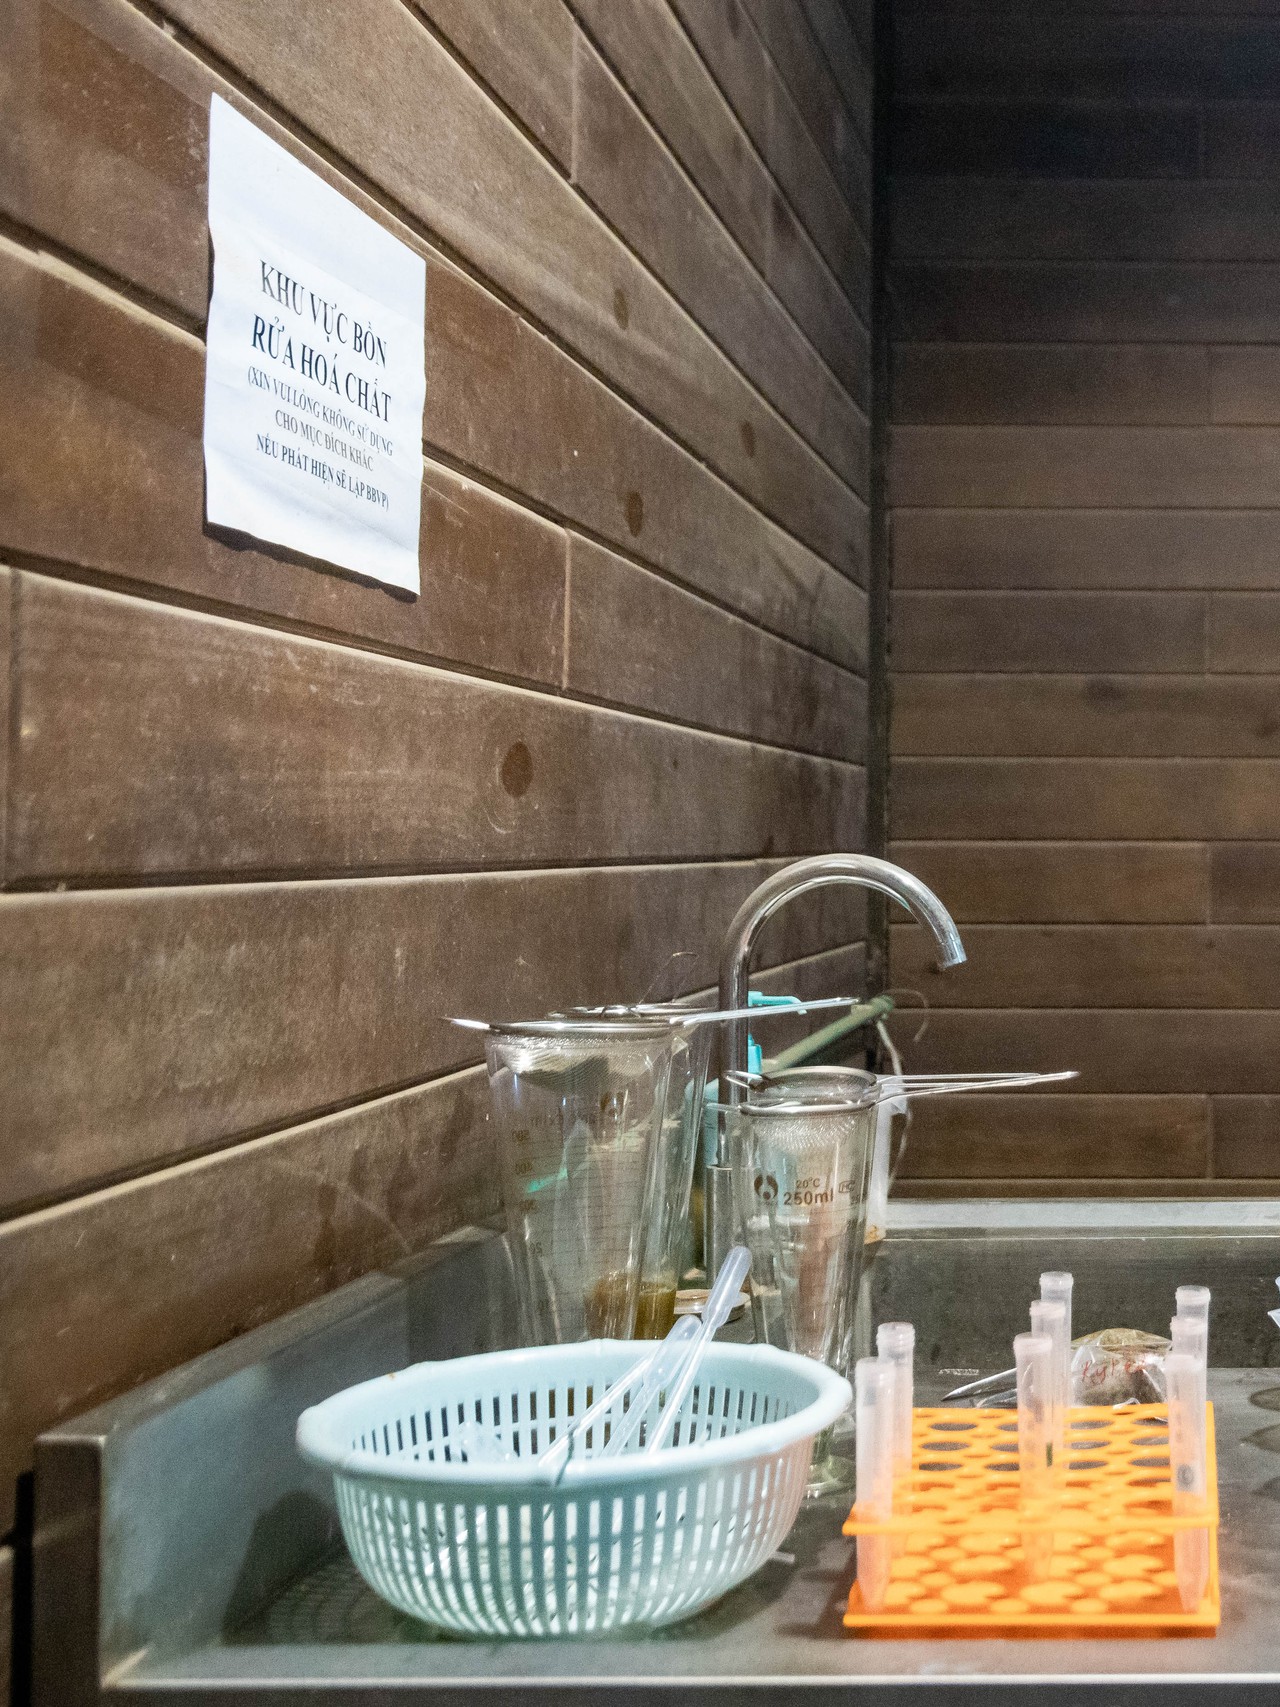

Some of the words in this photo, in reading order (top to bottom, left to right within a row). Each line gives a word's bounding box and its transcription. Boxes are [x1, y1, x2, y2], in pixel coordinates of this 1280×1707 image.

[259, 259, 305, 316] KHU
[309, 291, 349, 345] VỰC
[352, 321, 387, 368] BỒN
[251, 313, 296, 370] RỬA
[300, 342, 341, 396] HOÁ
[345, 372, 392, 423] CHẤT
[247, 365, 271, 391] (XIN
[272, 378, 292, 403] VUI
[292, 388, 320, 418] LÒNG
[322, 404, 355, 437] KHÔNG
[369, 431, 394, 456] DỤNG
[275, 409, 299, 434] CHO
[300, 421, 323, 447] MỤC
[324, 432, 348, 459] ĐÍCH
[348, 444, 374, 472] KHÁC
[256, 432, 279, 459] NẾU
[281, 444, 309, 472] PHÁT
[310, 458, 334, 484] HIỆN
[783, 1187, 834, 1206] 250ml
